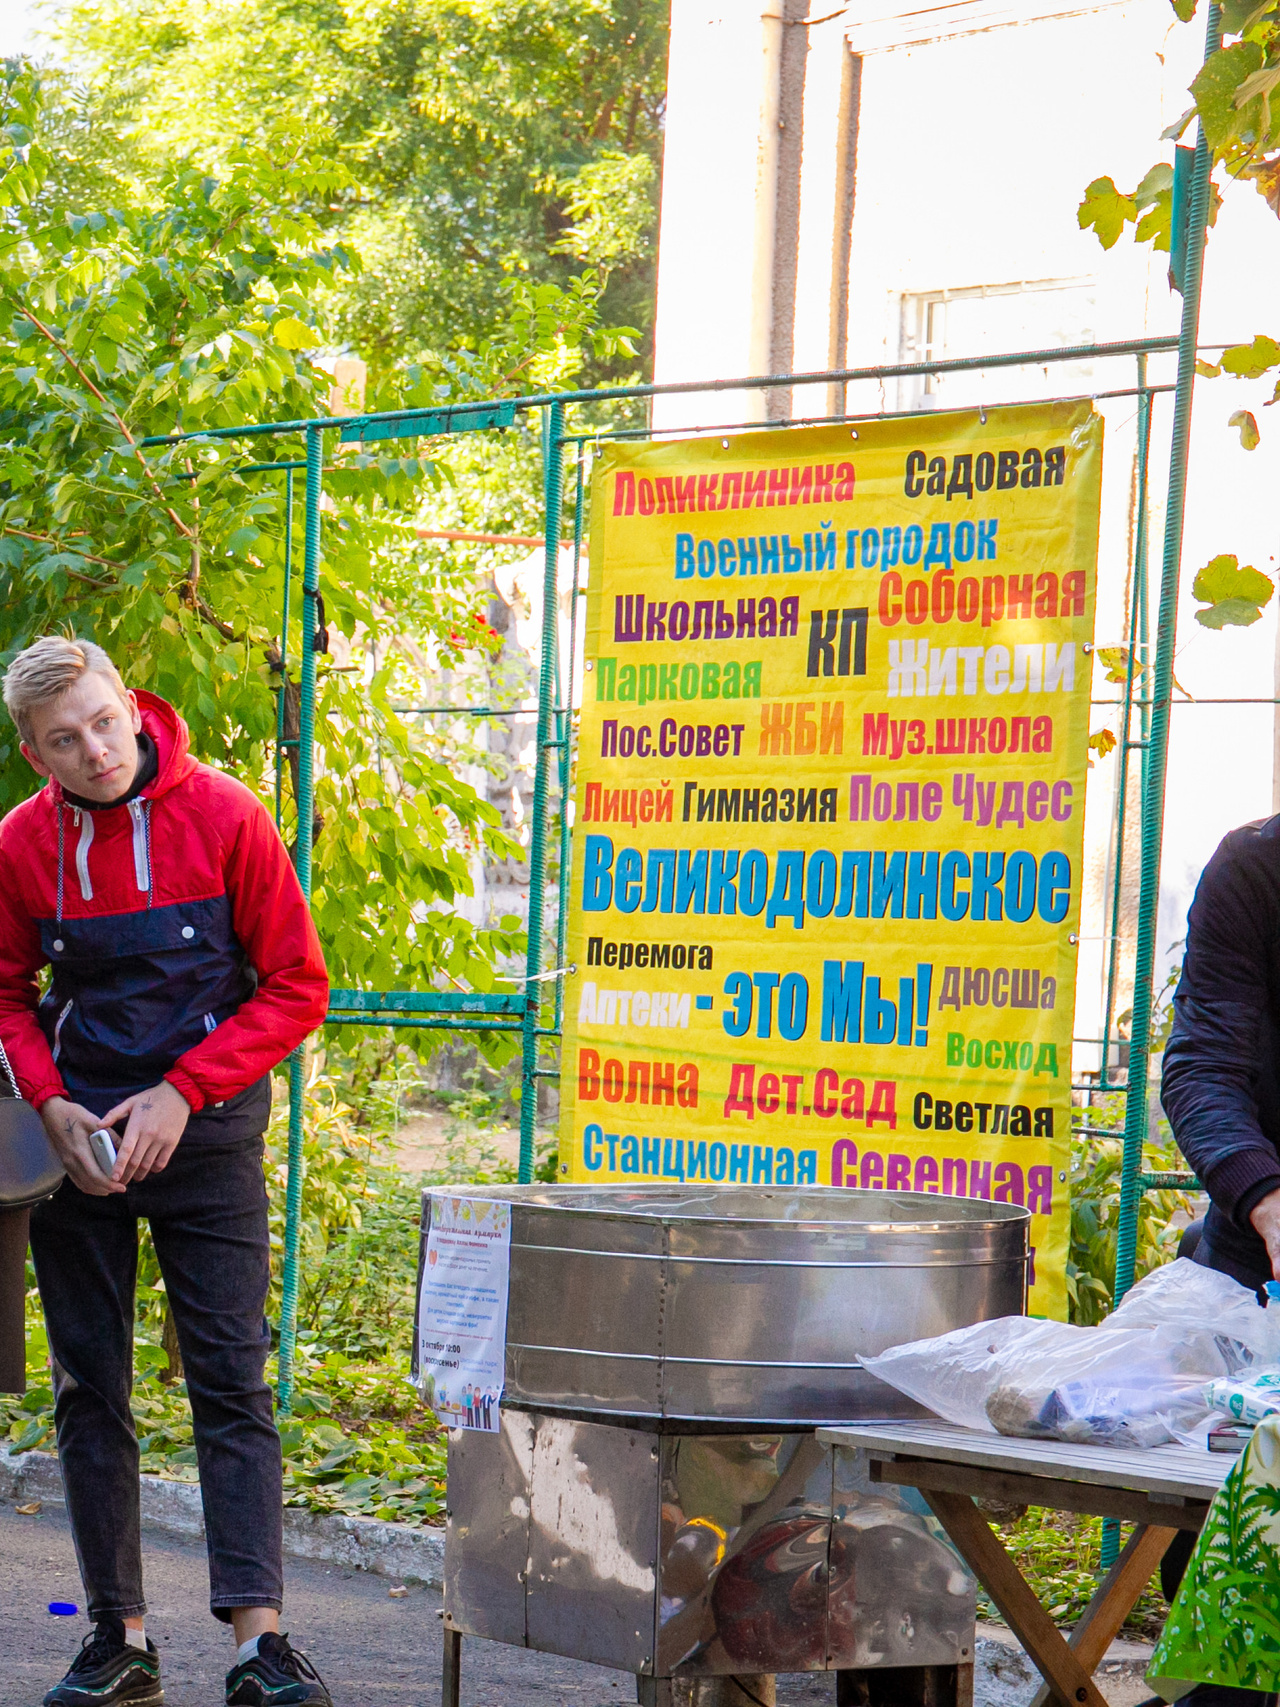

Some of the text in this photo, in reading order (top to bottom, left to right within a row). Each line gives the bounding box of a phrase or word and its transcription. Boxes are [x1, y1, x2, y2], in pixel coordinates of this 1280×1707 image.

[613, 462, 855, 516] Поликлиника
[904, 446, 1065, 501] Садовая
[674, 519, 998, 579] Военный городок
[614, 595, 799, 642] Школьная
[878, 570, 1086, 627] Соборная
[806, 607, 869, 678] КП
[887, 638, 1076, 698] Жители
[596, 660, 762, 705] Парковая
[601, 719, 745, 758] Пос.Совет
[759, 702, 845, 755] ЖБИ
[862, 712, 1052, 760] Муз.школа
[582, 780, 674, 828] Лицей
[682, 782, 838, 823] Гимназия
[849, 773, 1073, 828] Поле Чудес
[582, 834, 1071, 930] Великодолинское
[587, 937, 713, 970] Перемога
[578, 982, 690, 1028] Аптеки
[722, 970, 810, 1041] это
[820, 959, 933, 1047] Мы!
[938, 966, 1057, 1011] ДЮСШа
[579, 1049, 699, 1108] Волна
[946, 1032, 1058, 1078] Восход
[724, 1063, 897, 1130] Дет.Сад
[913, 1092, 1054, 1138] Светлая
[583, 1123, 817, 1184] Станционная
[831, 1138, 1053, 1214] Северная
